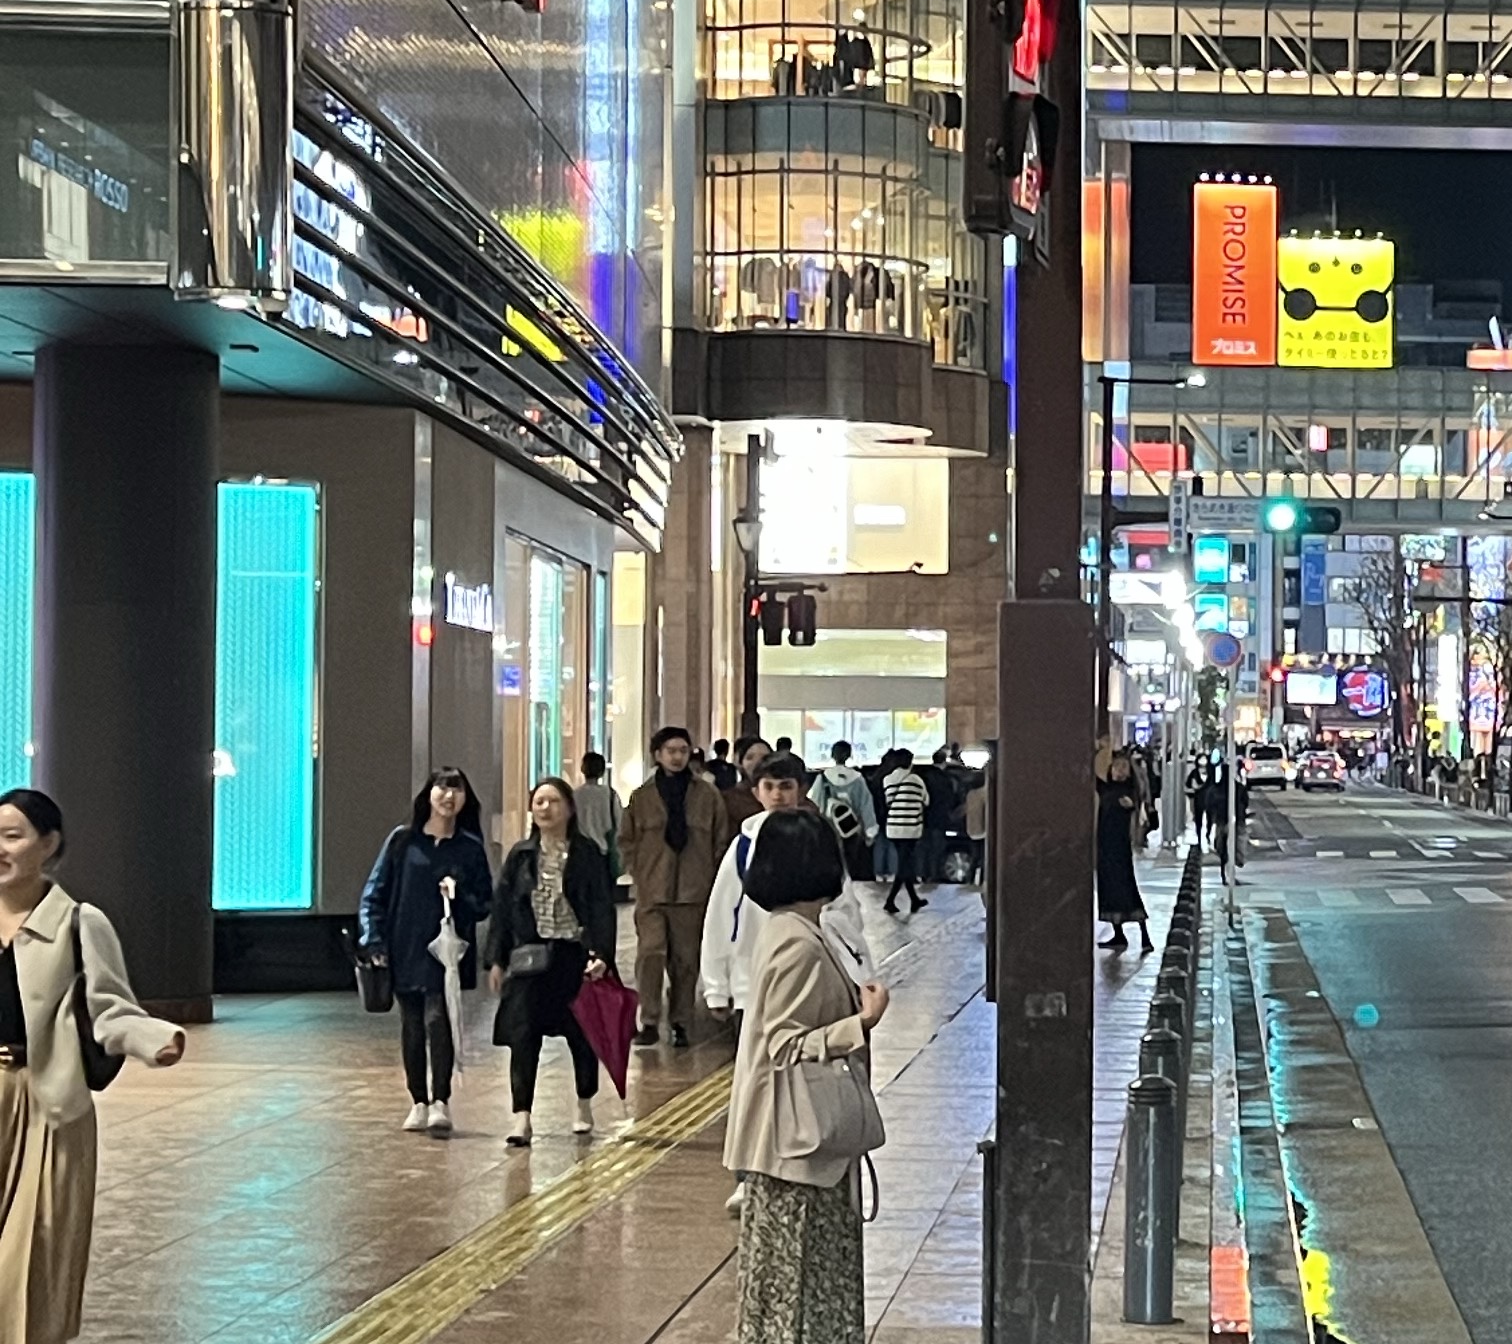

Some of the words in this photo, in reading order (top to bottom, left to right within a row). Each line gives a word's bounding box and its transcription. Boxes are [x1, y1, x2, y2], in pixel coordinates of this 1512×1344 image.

[1221, 204, 1246, 325] PROMISE
[1210, 338, 1257, 356] プロミス
